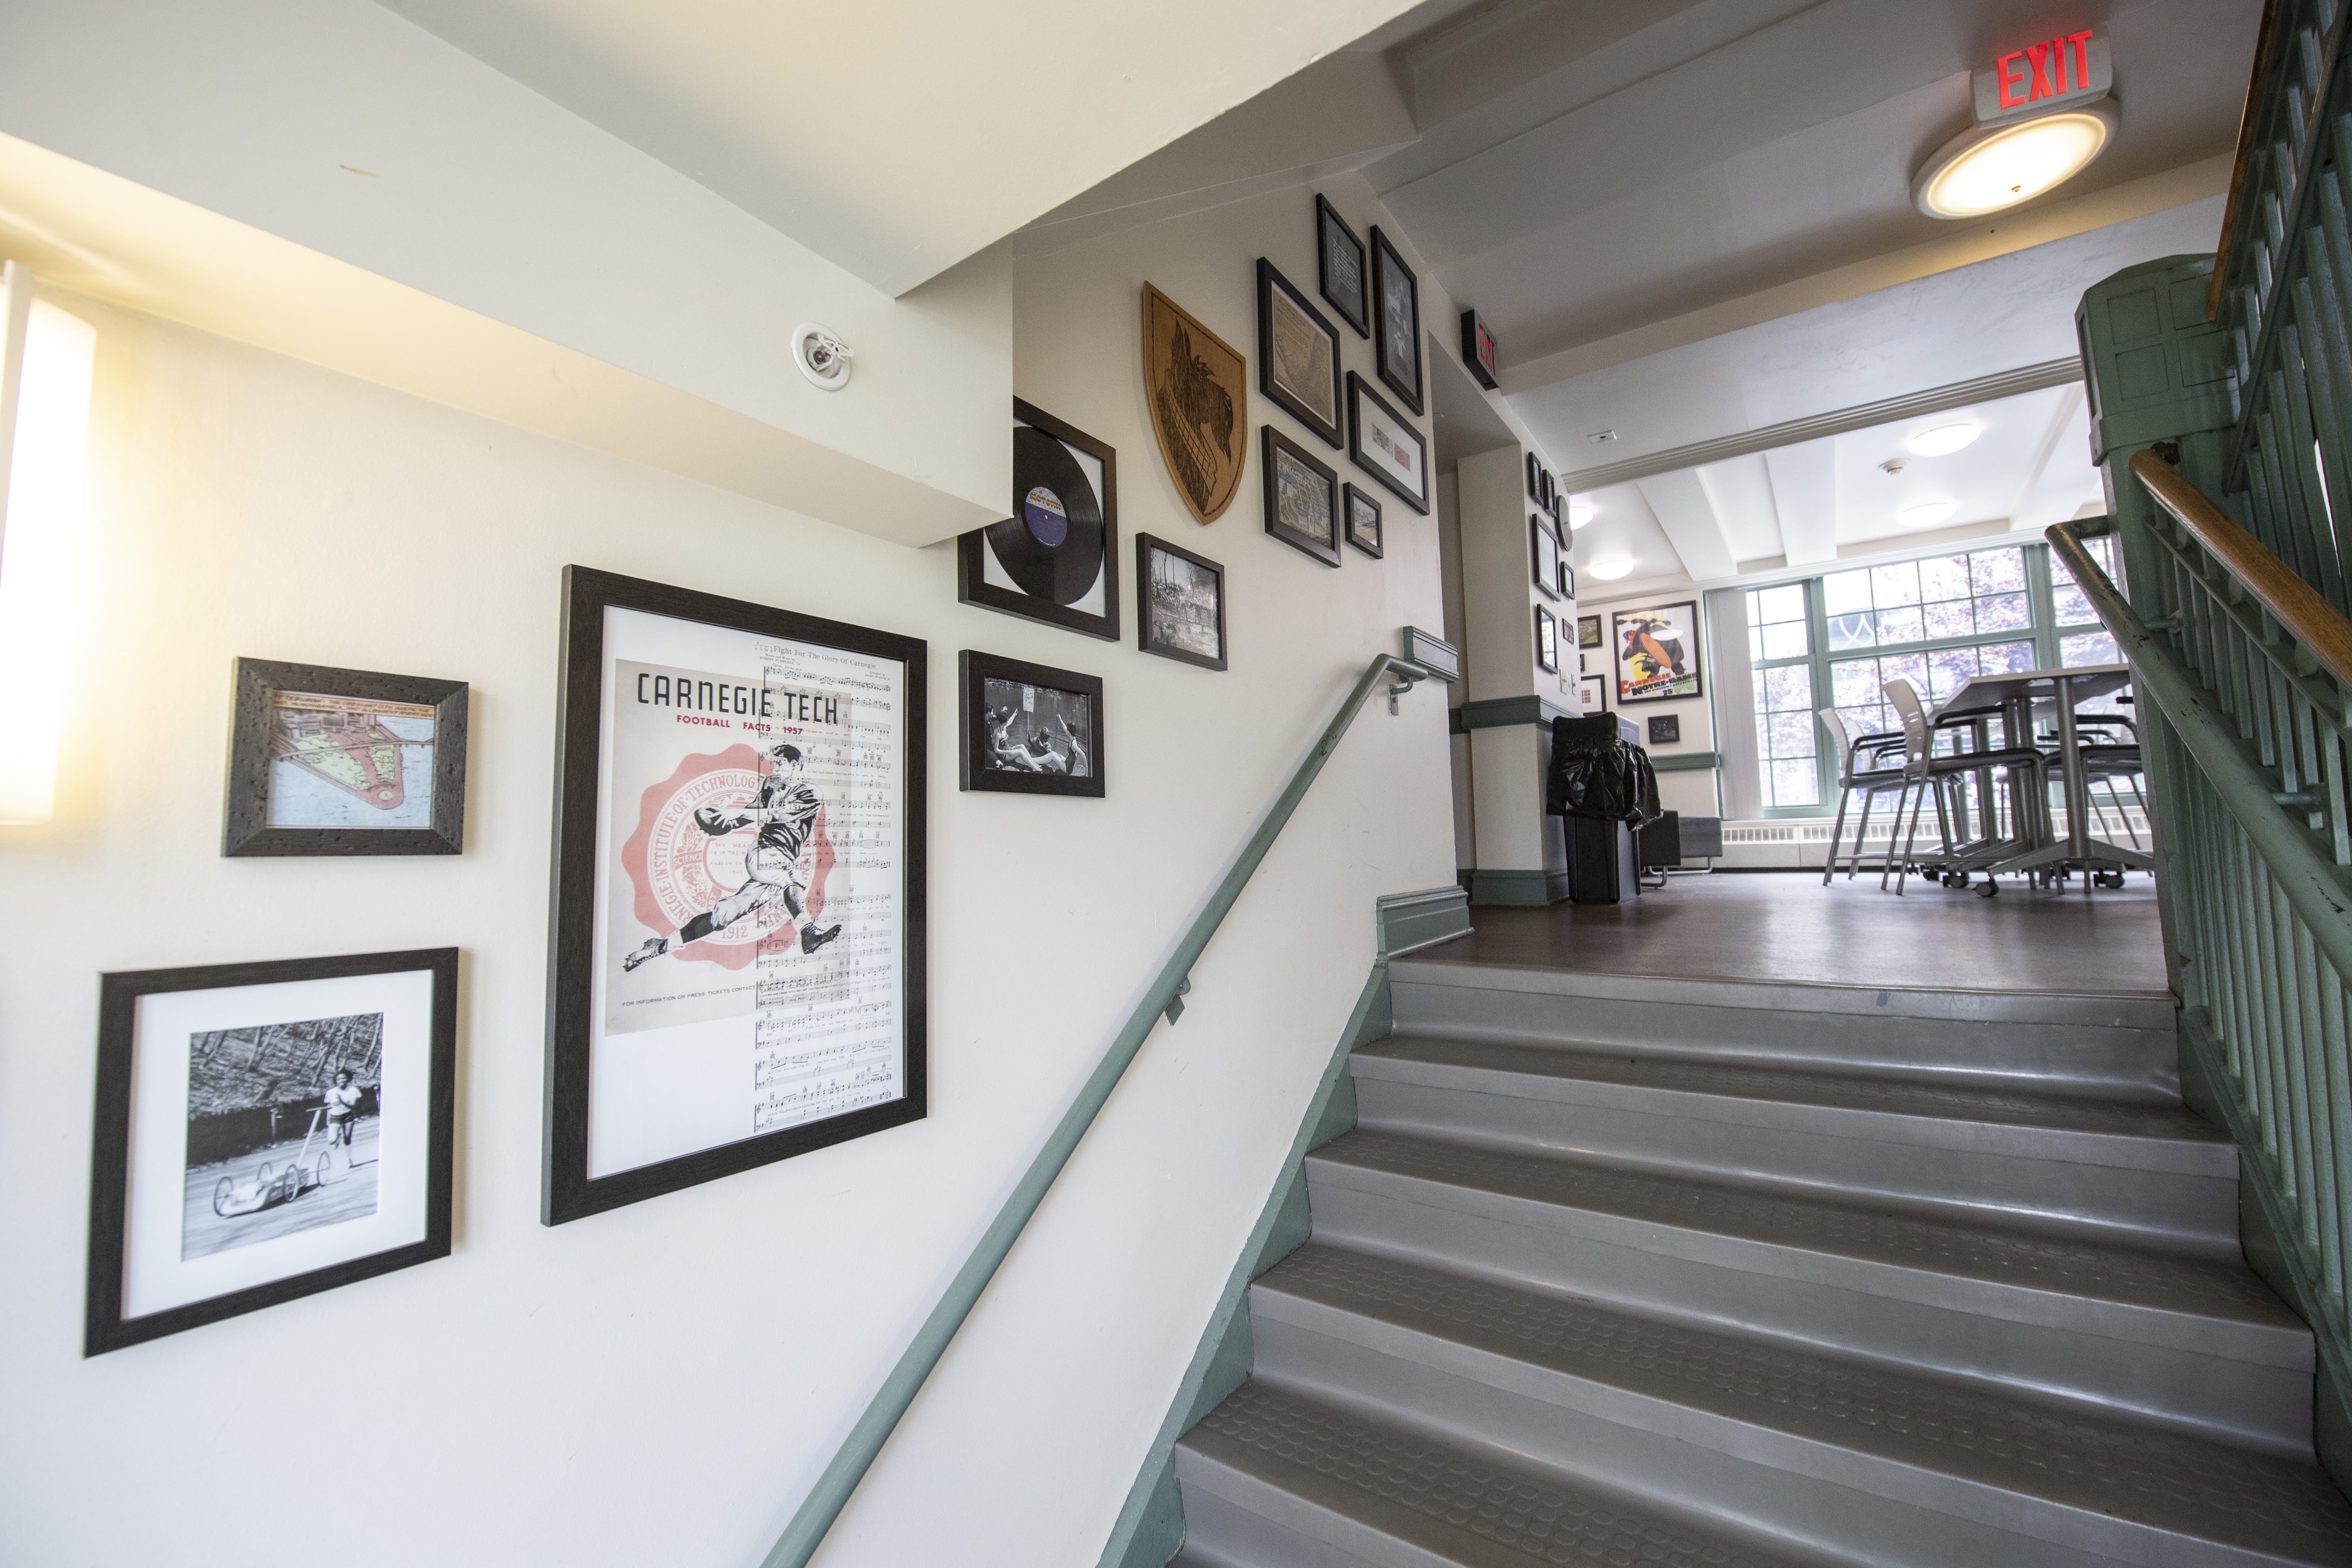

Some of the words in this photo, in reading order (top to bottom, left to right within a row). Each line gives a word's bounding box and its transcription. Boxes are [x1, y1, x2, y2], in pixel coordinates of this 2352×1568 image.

[1997, 30, 2092, 109] EXIT
[1030, 492, 1061, 510] MOTOWN
[773, 645, 792, 655] Fight
[808, 652, 820, 660] The
[822, 655, 838, 665] Glory
[850, 659, 877, 669] Carnegie
[1621, 672, 1671, 694] CARNEGIE
[638, 673, 771, 717] CARNEGIE
[784, 692, 837, 724] TECH
[677, 714, 730, 728] FOOTBALL
[743, 721, 771, 732] FACTS
[783, 726, 803, 735] 1957
[686, 775, 762, 801] TECHNOLOGY
[672, 796, 689, 814] OF
[654, 811, 678, 882] INSTITUTE
[673, 853, 702, 866] SCIENCE
[659, 882, 695, 925] RNEGIE
[721, 925, 748, 939] 1912
[636, 996, 676, 1005] INFORMATION
